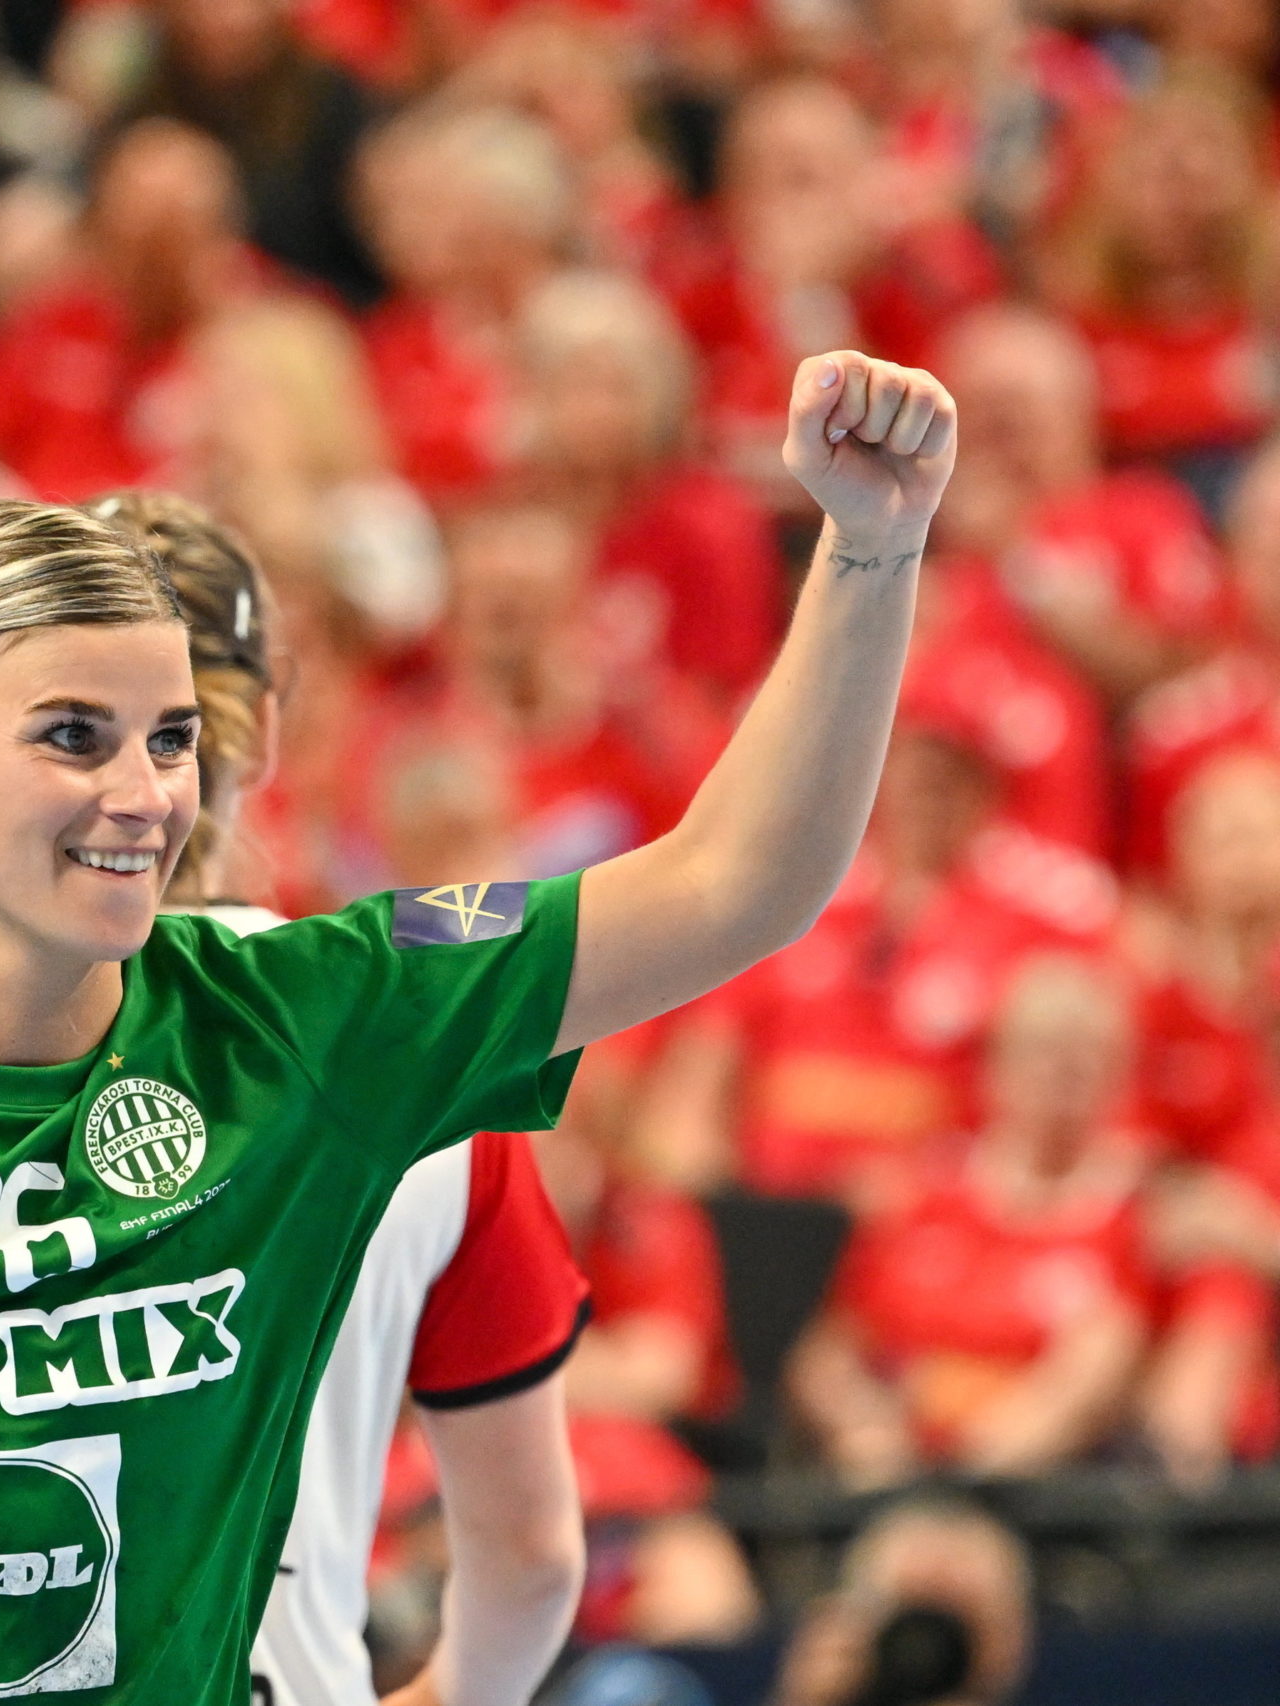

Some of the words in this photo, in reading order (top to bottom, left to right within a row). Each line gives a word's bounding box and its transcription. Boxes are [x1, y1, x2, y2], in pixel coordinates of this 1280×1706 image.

[133, 1080, 181, 1106] TORNA
[182, 1104, 204, 1139] CLUB
[135, 1185, 150, 1196] 18
[178, 1164, 193, 1179] 99
[120, 1216, 148, 1231] EHF
